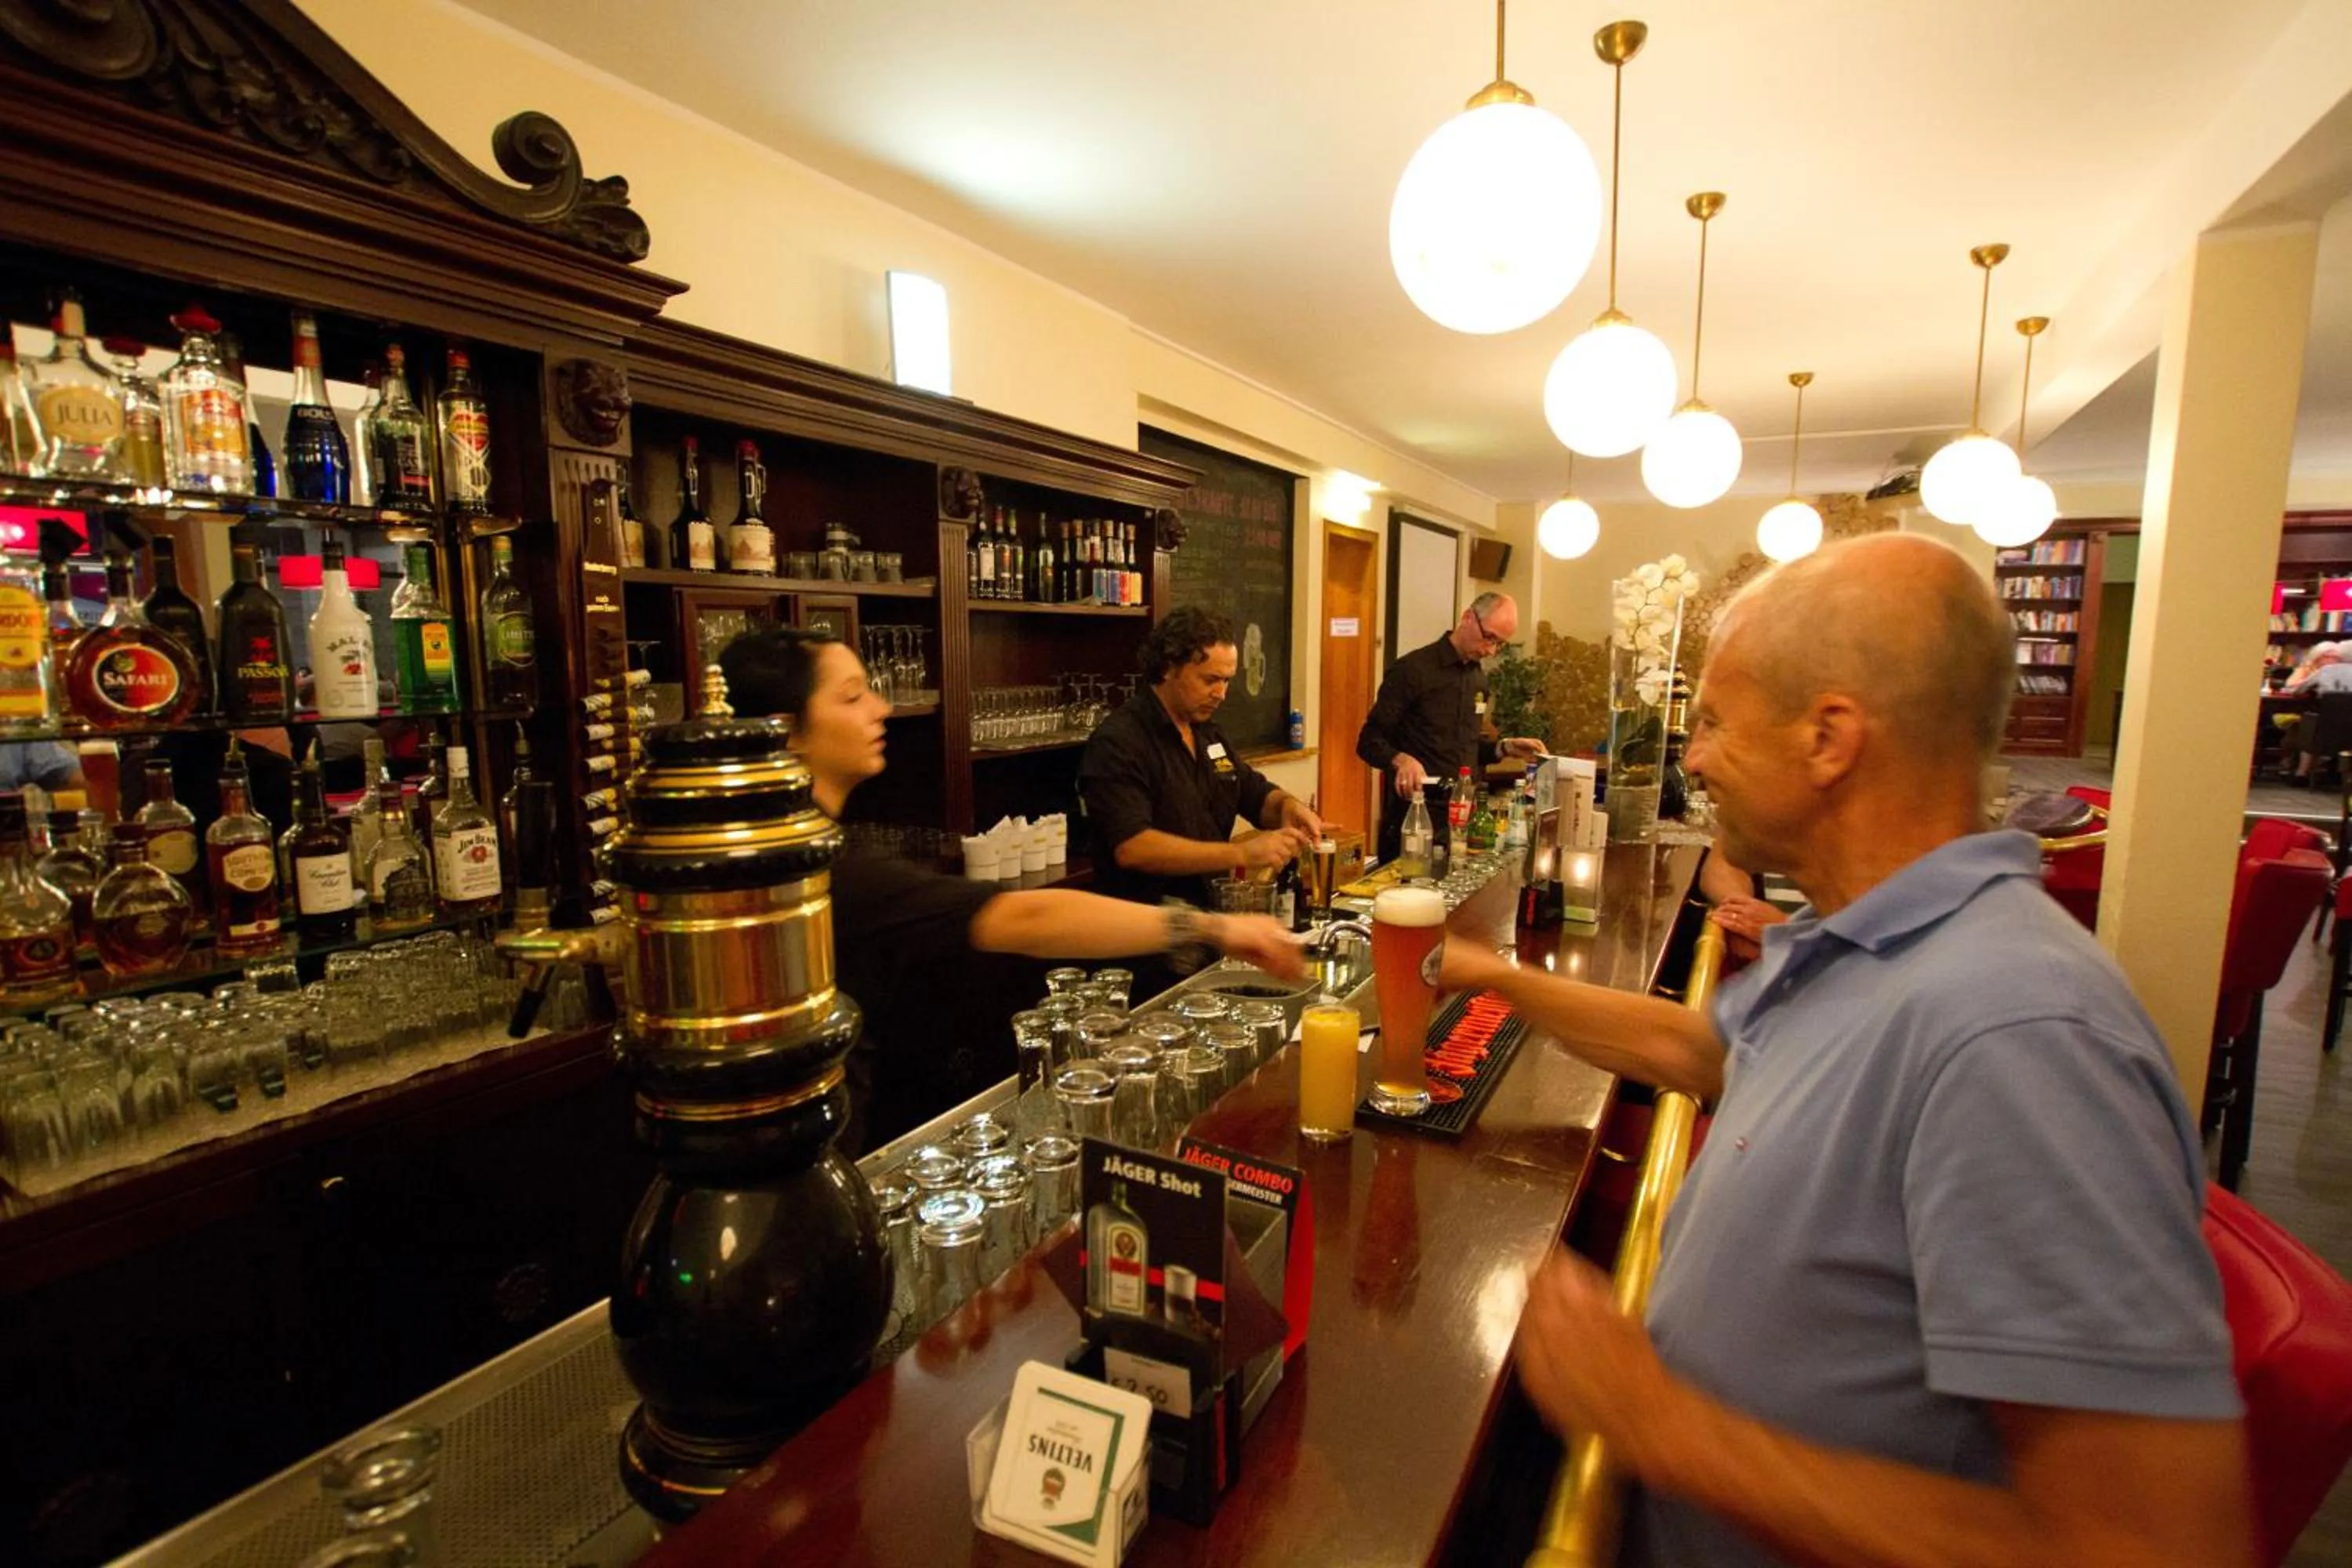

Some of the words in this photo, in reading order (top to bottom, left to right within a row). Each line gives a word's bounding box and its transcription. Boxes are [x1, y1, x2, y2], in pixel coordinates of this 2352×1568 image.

[56, 404, 113, 426] JULIA
[103, 671, 168, 686] SAFARI
[1102, 1155, 1156, 1186] JÄGER
[1160, 1171, 1202, 1199] Shot
[1234, 1163, 1294, 1195] COMBO
[1028, 1433, 1093, 1474] VELTINS
